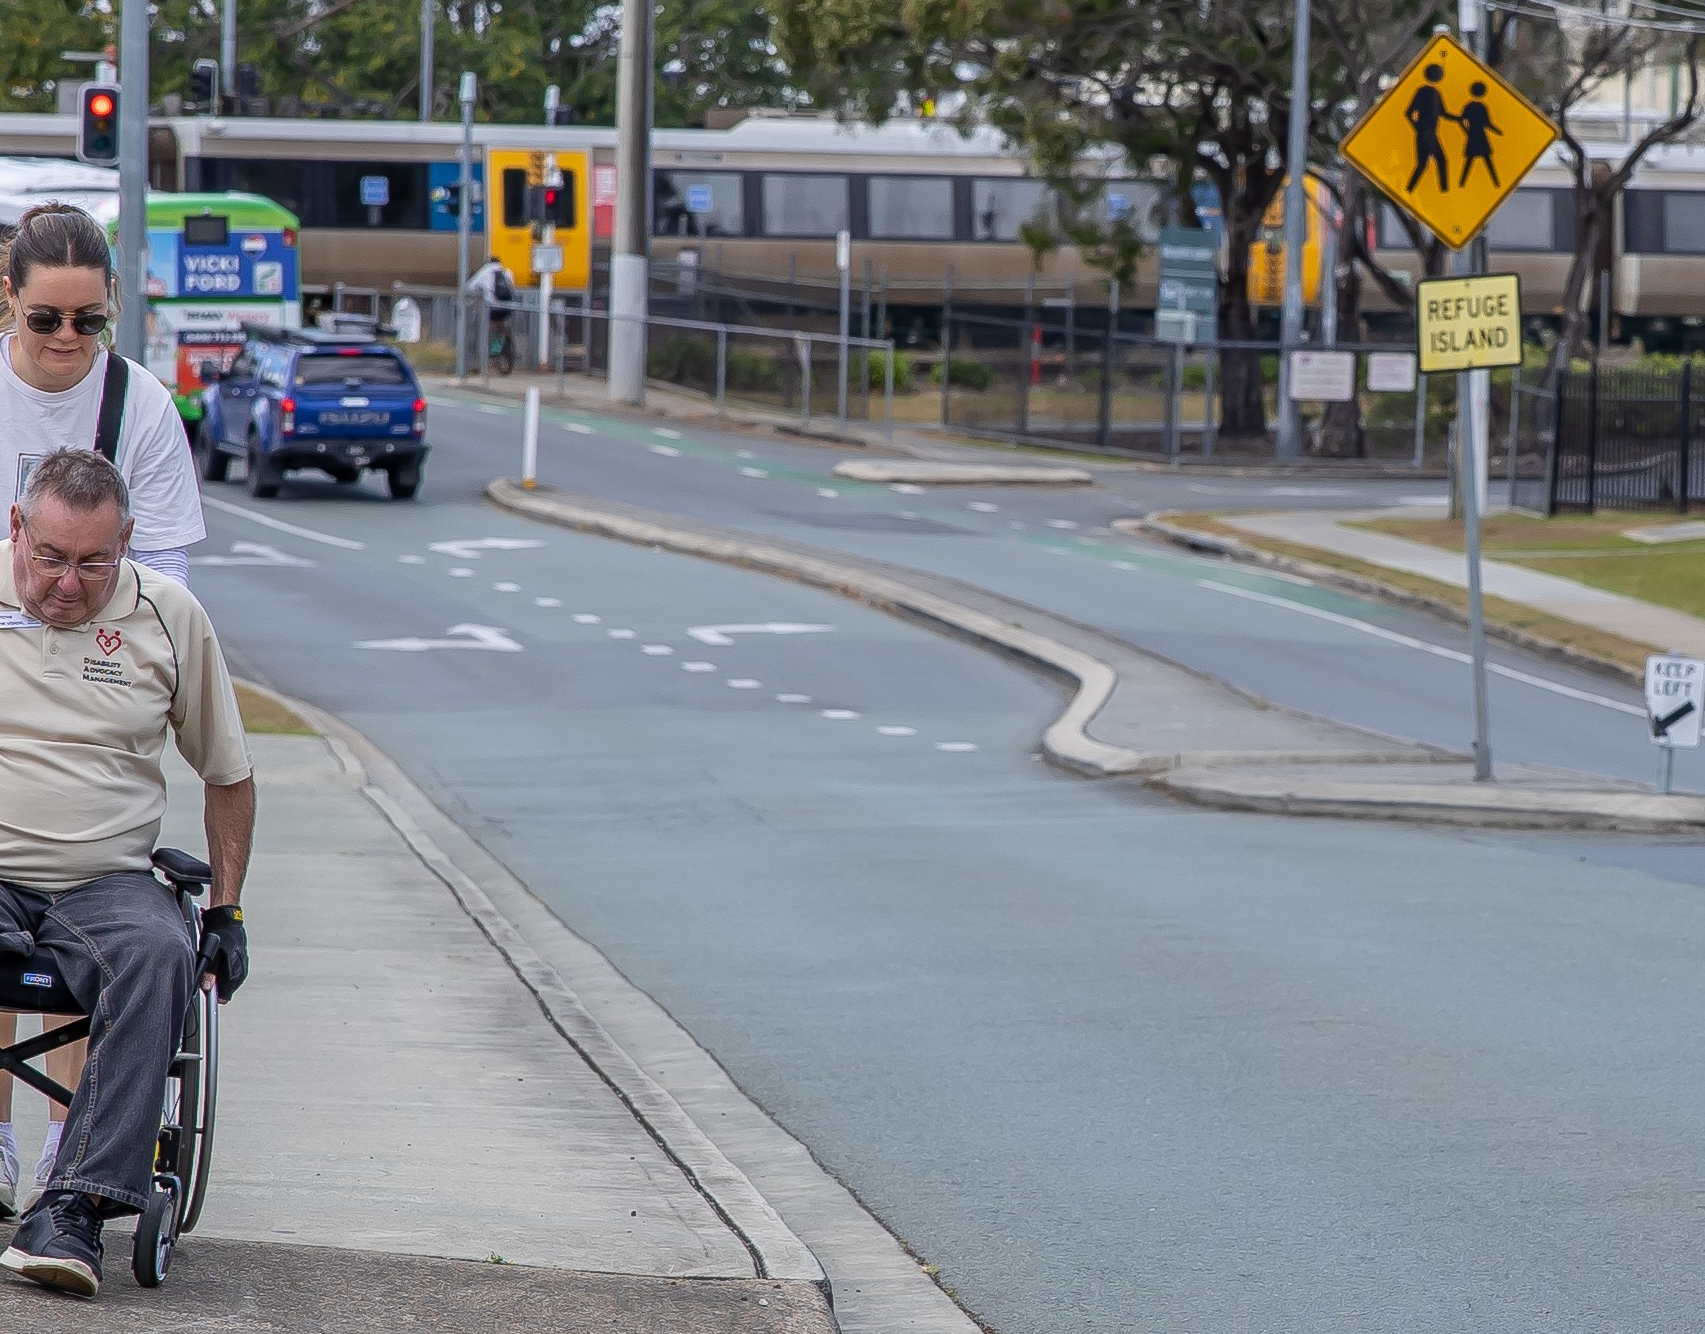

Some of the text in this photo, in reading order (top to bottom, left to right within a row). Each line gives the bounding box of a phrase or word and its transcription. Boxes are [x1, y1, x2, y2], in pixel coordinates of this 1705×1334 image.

[184, 254, 240, 273] VICKI
[185, 273, 241, 291] FORD
[1427, 294, 1509, 322] REFUGE
[1430, 326, 1509, 354] ISLAND
